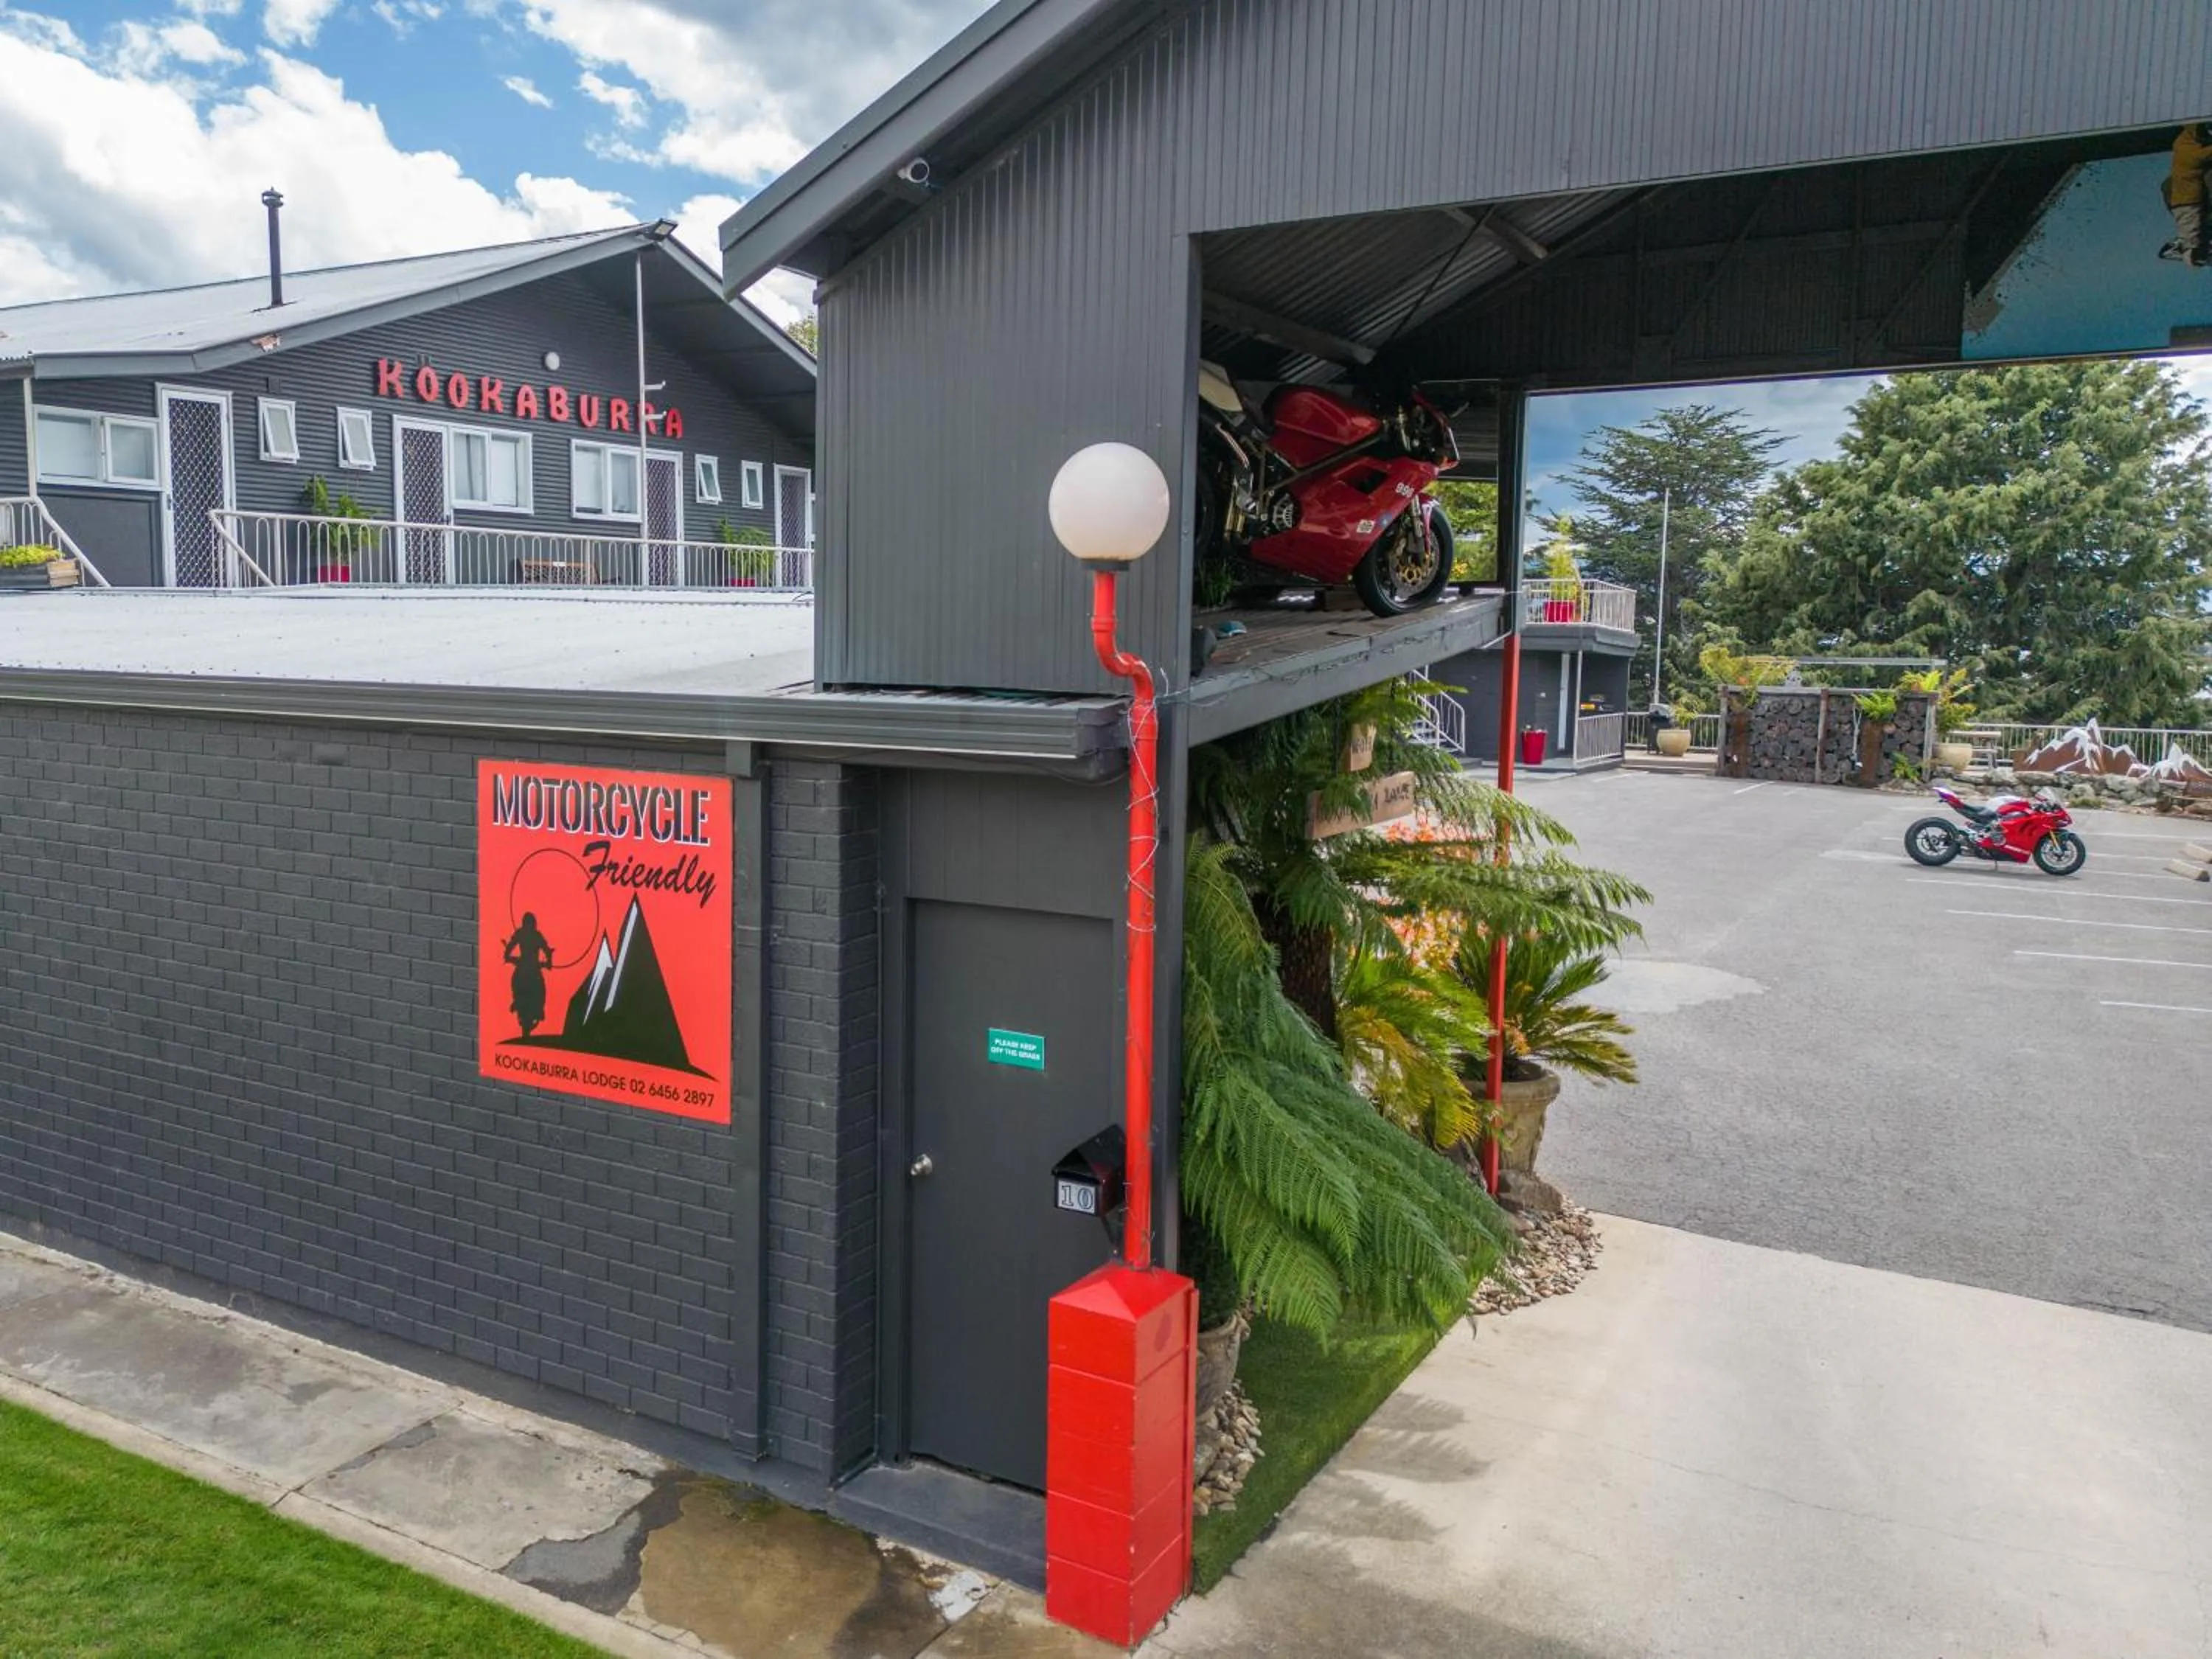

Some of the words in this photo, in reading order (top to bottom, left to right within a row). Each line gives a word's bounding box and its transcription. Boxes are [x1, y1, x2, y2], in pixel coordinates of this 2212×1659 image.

[377, 357, 684, 439] KOOKABURRA
[493, 773, 712, 846] MOTORCYCLE
[582, 840, 717, 909] Friendly
[495, 1052, 578, 1081] KOOKABURRA
[583, 1071, 627, 1091] LODGE
[629, 1078, 646, 1096] 02
[648, 1083, 680, 1102] 6456
[683, 1088, 715, 1107] 2897
[1061, 1185, 1093, 1210] 10
